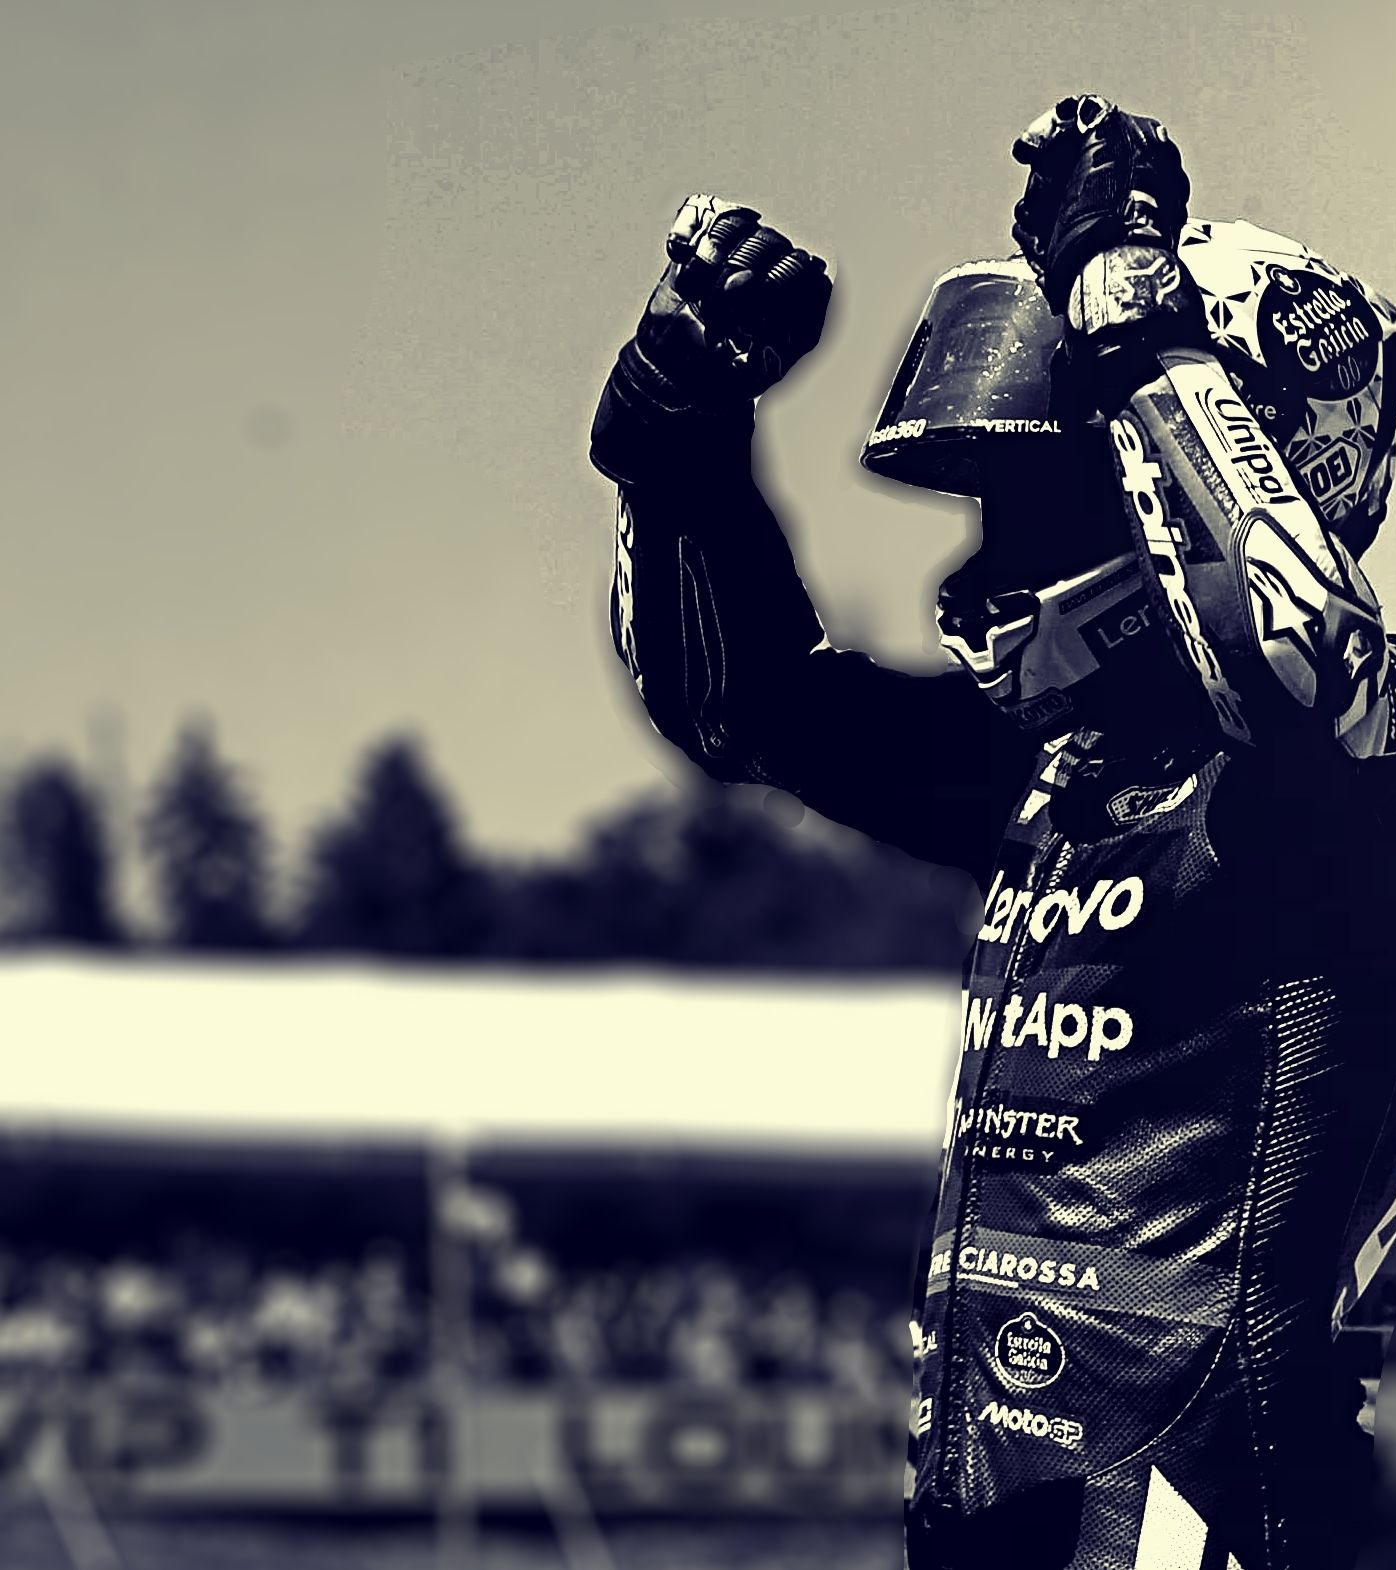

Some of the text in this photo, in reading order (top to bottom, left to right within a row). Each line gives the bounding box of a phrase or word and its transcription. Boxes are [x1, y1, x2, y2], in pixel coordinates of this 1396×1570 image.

[982, 418, 1062, 434] VERTICAL
[1303, 445, 1354, 498] OEI
[1109, 417, 1257, 748] alpinesta
[963, 991, 1134, 1062] NtApp
[957, 1103, 1084, 1146] MNSTER
[964, 1145, 1055, 1162] NERGY
[928, 1246, 1101, 1292] RECIAROSSA
